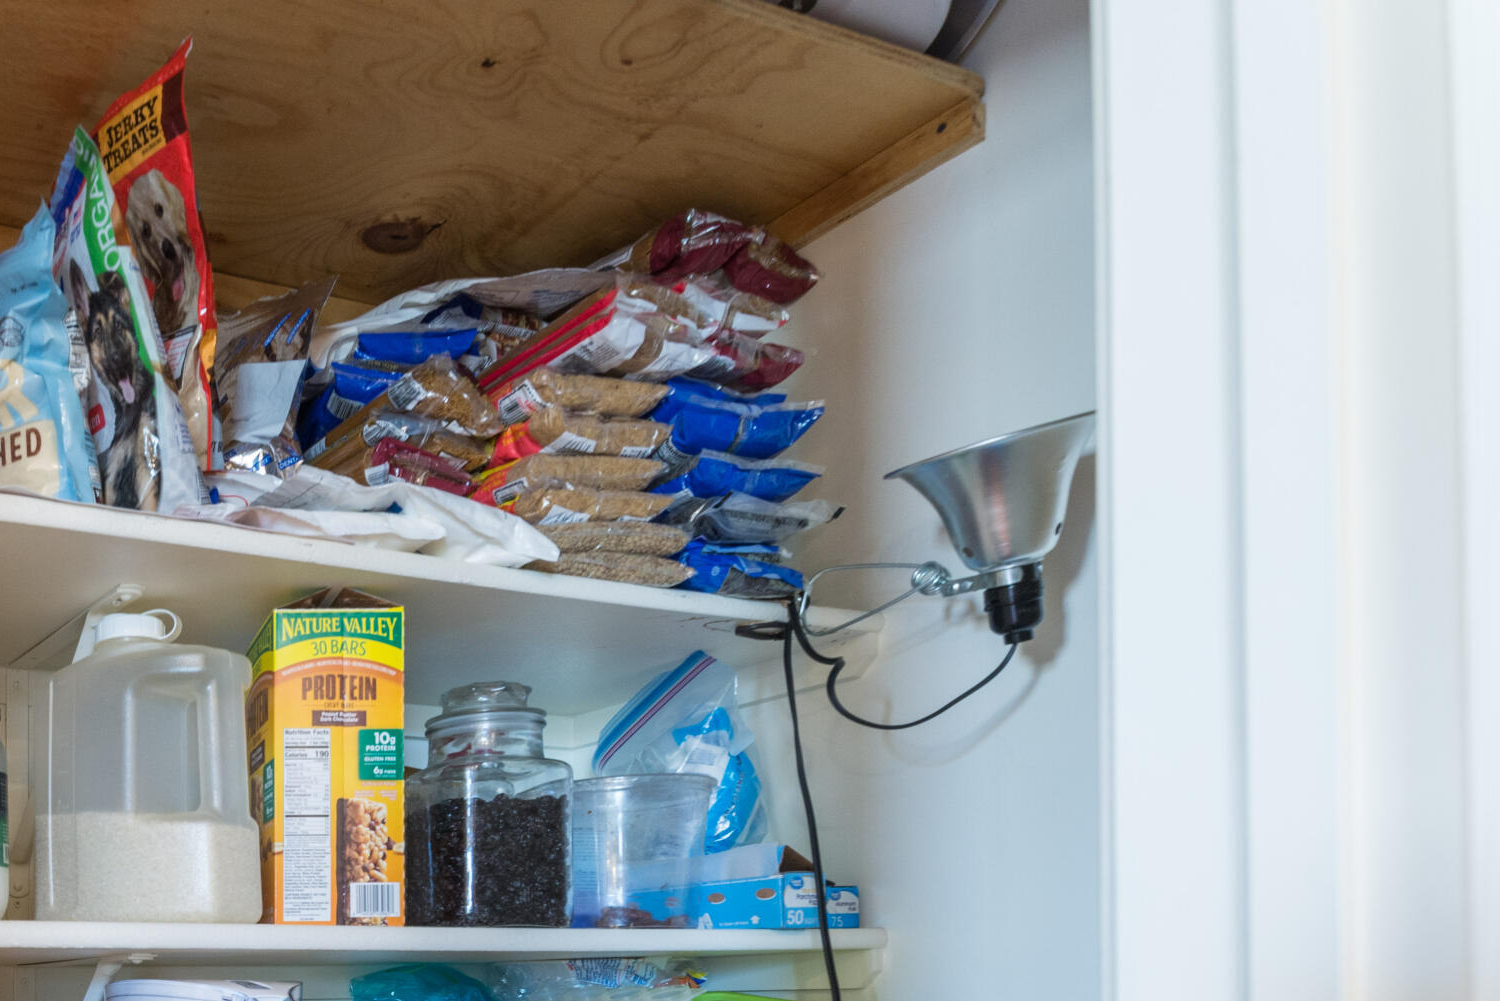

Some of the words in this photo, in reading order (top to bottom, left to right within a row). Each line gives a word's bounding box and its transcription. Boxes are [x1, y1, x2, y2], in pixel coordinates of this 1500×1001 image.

[106, 95, 158, 148] JERKY
[103, 117, 159, 174] TREATS
[281, 617, 340, 641] NATURE
[343, 617, 397, 641] VALLEY
[312, 641, 328, 657] 30
[331, 640, 367, 657] BARS
[301, 674, 377, 701] PROTEIN
[373, 732, 396, 745] 10g
[315, 750, 329, 758] 190
[787, 910, 803, 925] 50
[831, 916, 843, 927] 75
